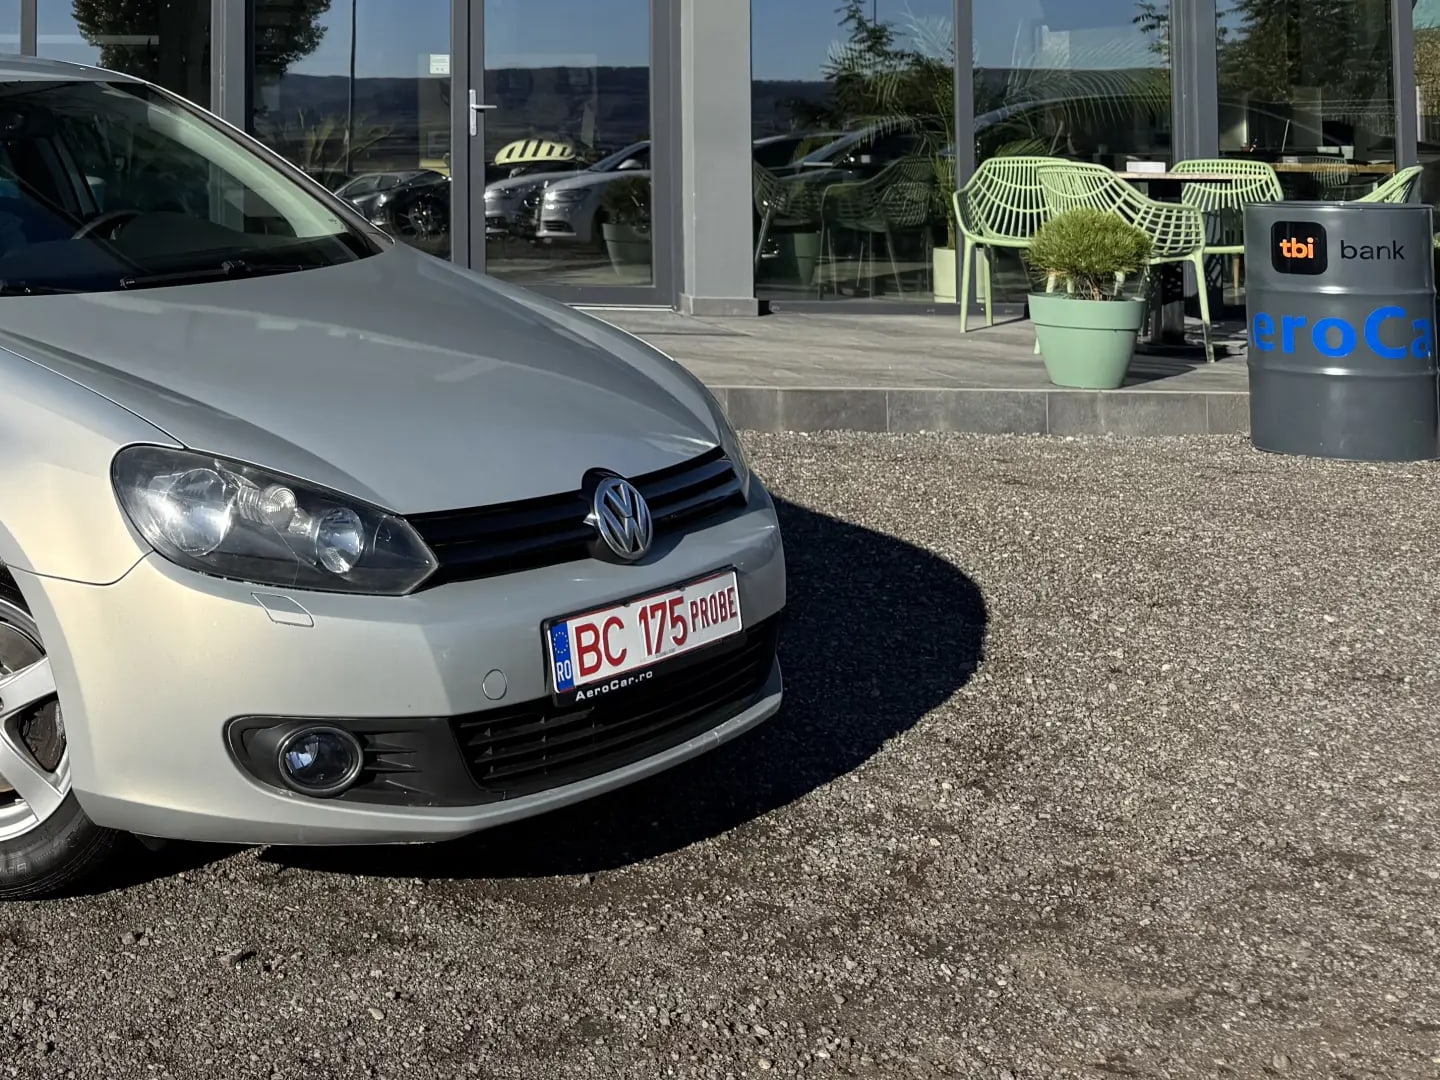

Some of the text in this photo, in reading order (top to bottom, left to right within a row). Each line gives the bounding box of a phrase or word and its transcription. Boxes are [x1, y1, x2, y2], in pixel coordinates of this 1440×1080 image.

[1279, 237, 1405, 260] tbi bank
[575, 587, 738, 678] BC 175 PROBE
[556, 660, 572, 683] RO
[575, 670, 653, 702] AeroCar.ro
